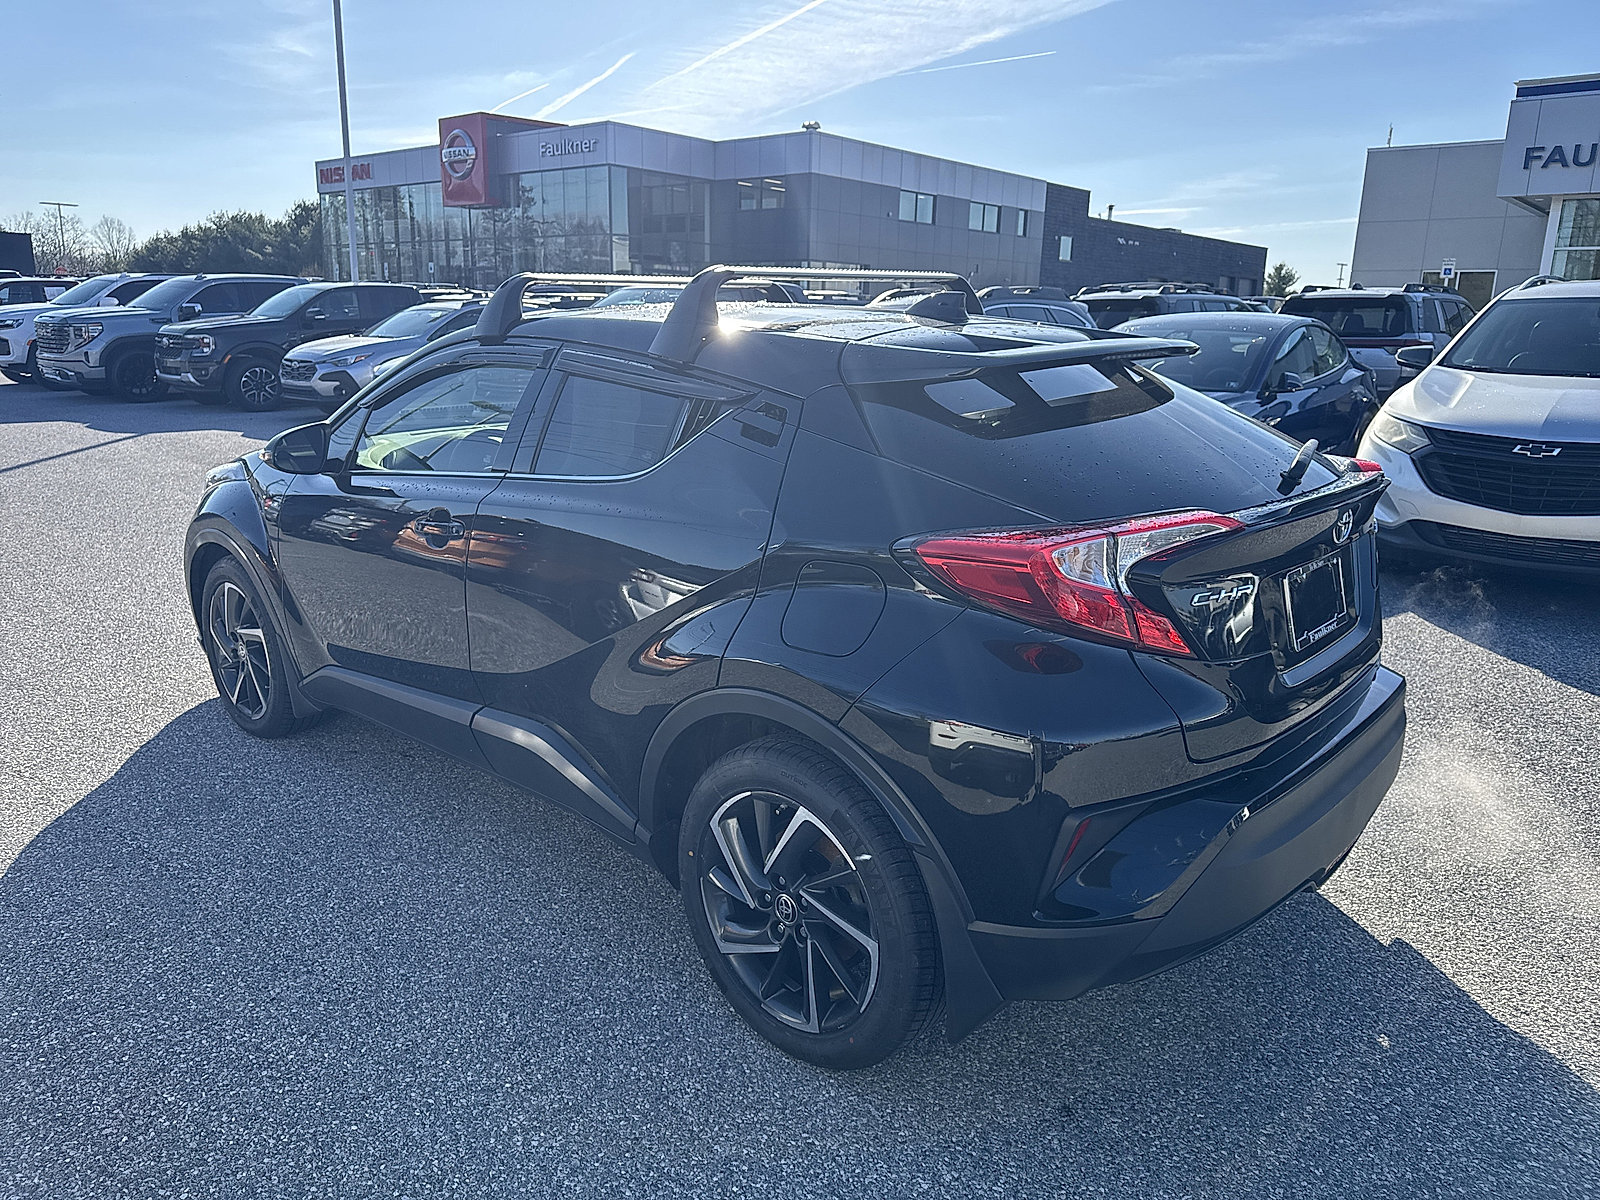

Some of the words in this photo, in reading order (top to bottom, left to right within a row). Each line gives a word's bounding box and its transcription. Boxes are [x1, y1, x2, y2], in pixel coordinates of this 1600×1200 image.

[539, 138, 597, 157] Faulkner
[1523, 143, 1599, 170] FAU
[319, 163, 371, 184] NISAN
[1191, 584, 1254, 607] C-HR
[1309, 620, 1338, 643] Faulkner
